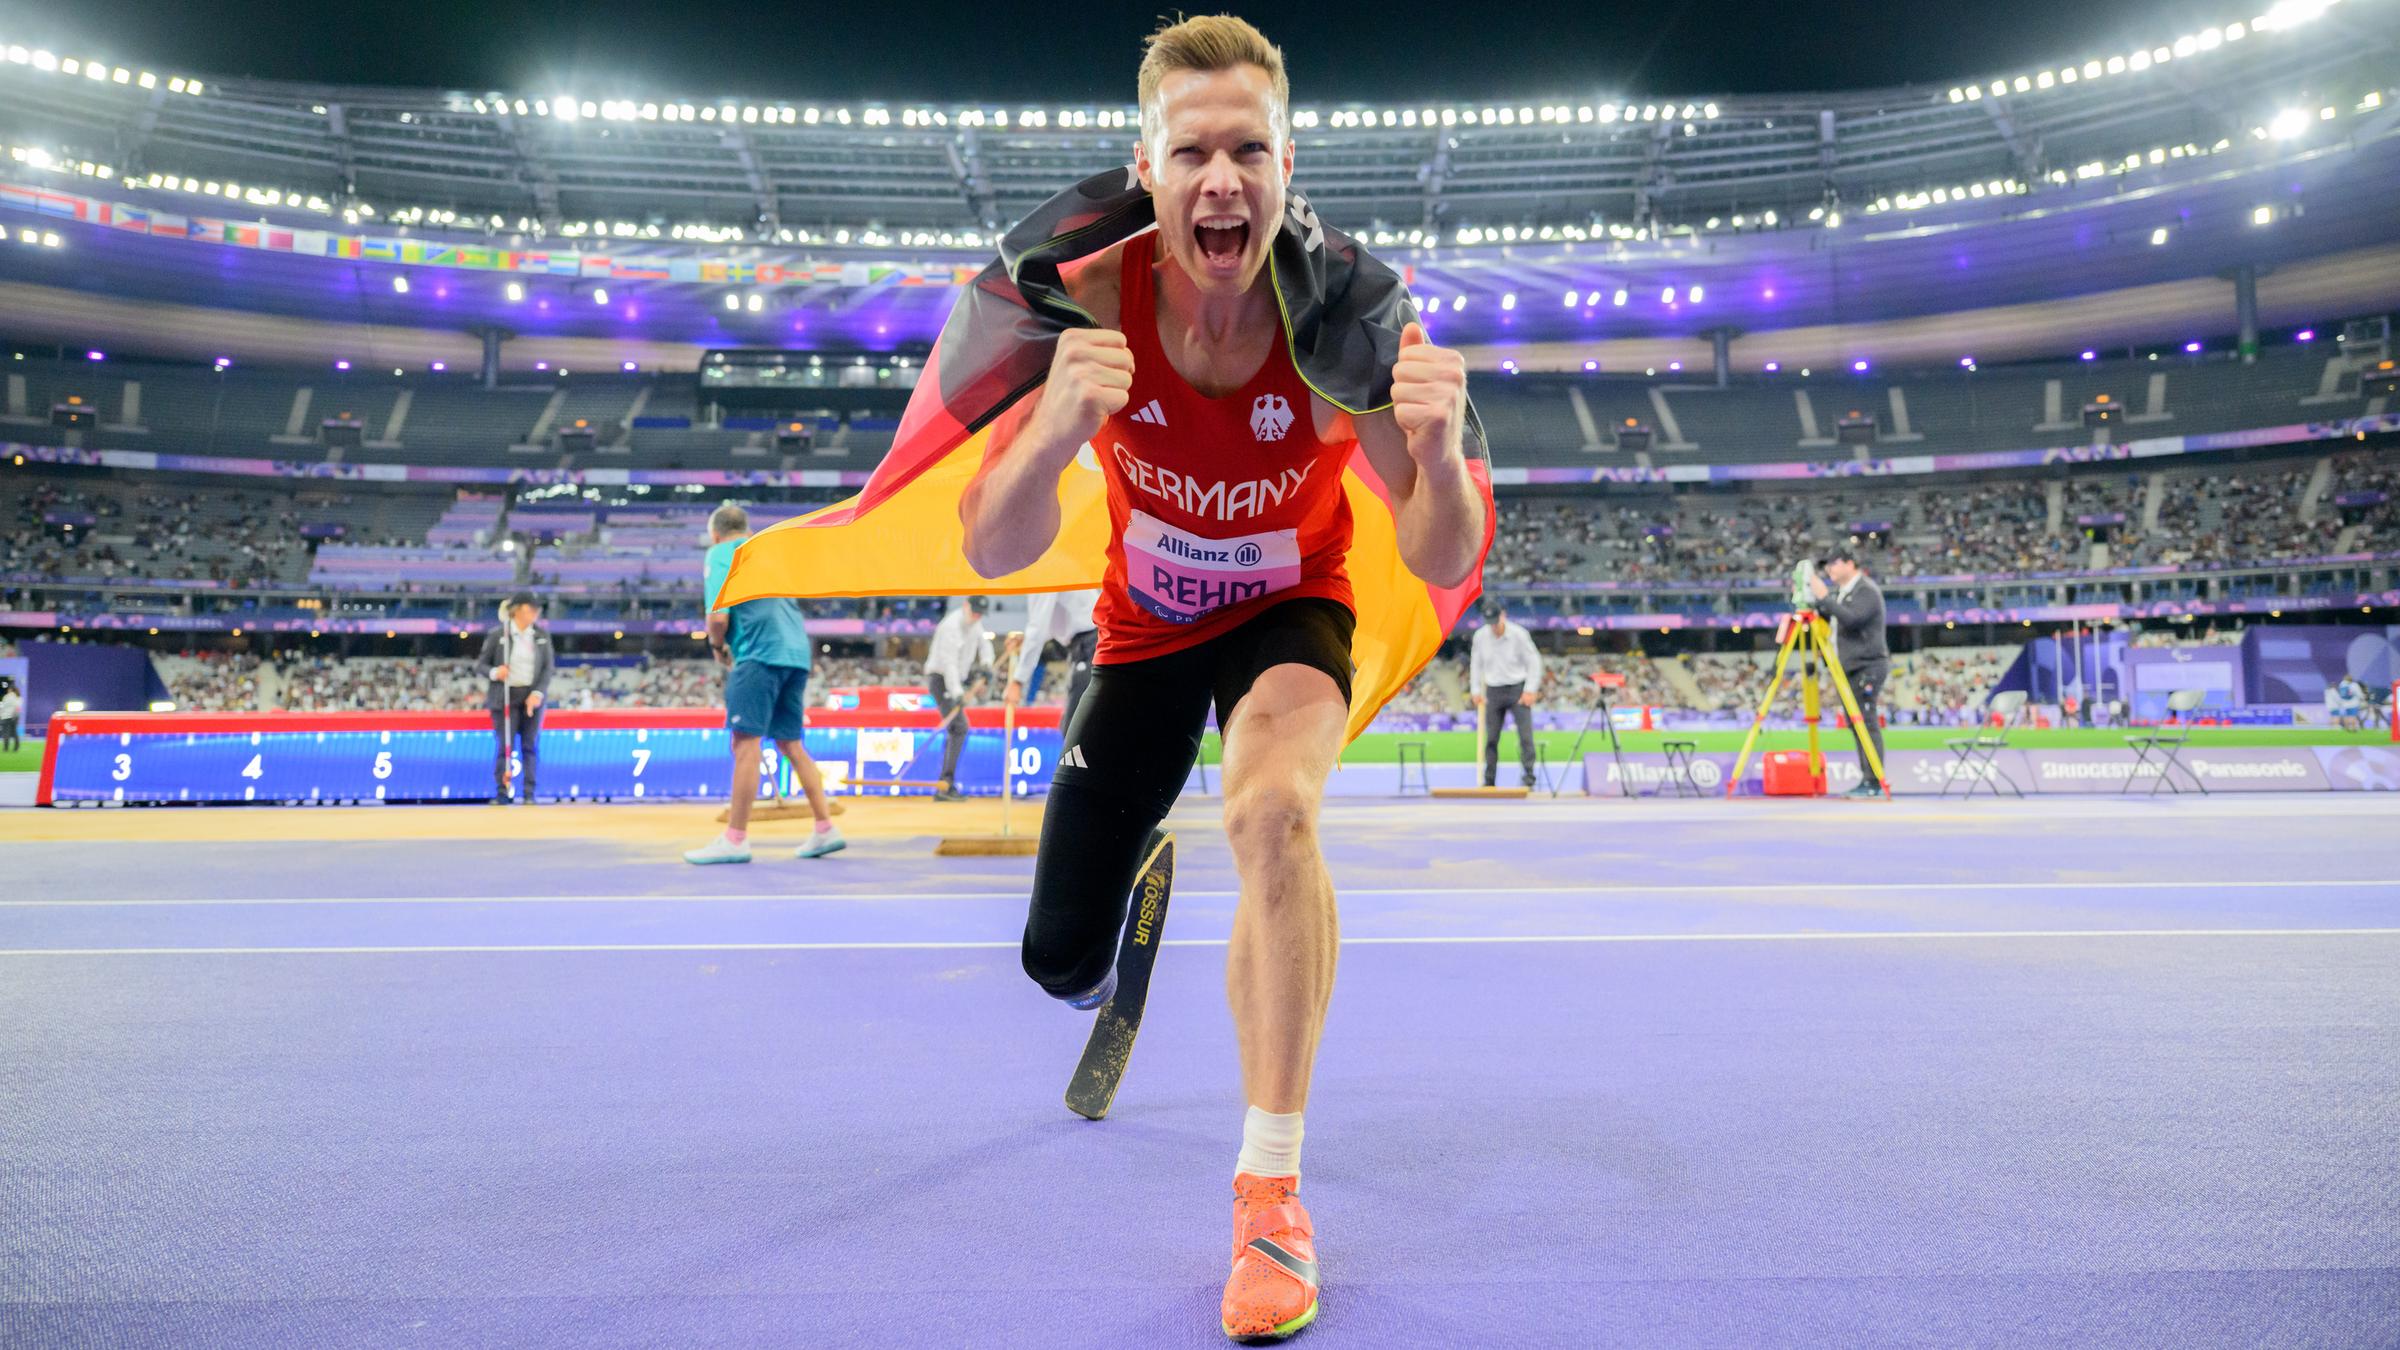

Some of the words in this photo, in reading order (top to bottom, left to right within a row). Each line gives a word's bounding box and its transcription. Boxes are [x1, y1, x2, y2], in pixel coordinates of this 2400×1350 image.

[1113, 442, 1317, 521] GERMANY
[1157, 533, 1229, 562] Allianz
[1153, 565, 1267, 607] REHM
[112, 753, 132, 780] 3
[241, 753, 263, 780] 4
[372, 751, 392, 779] 5
[631, 749, 651, 777] 7
[1008, 746, 1042, 775] 10
[2190, 758, 2307, 778] Panasonic
